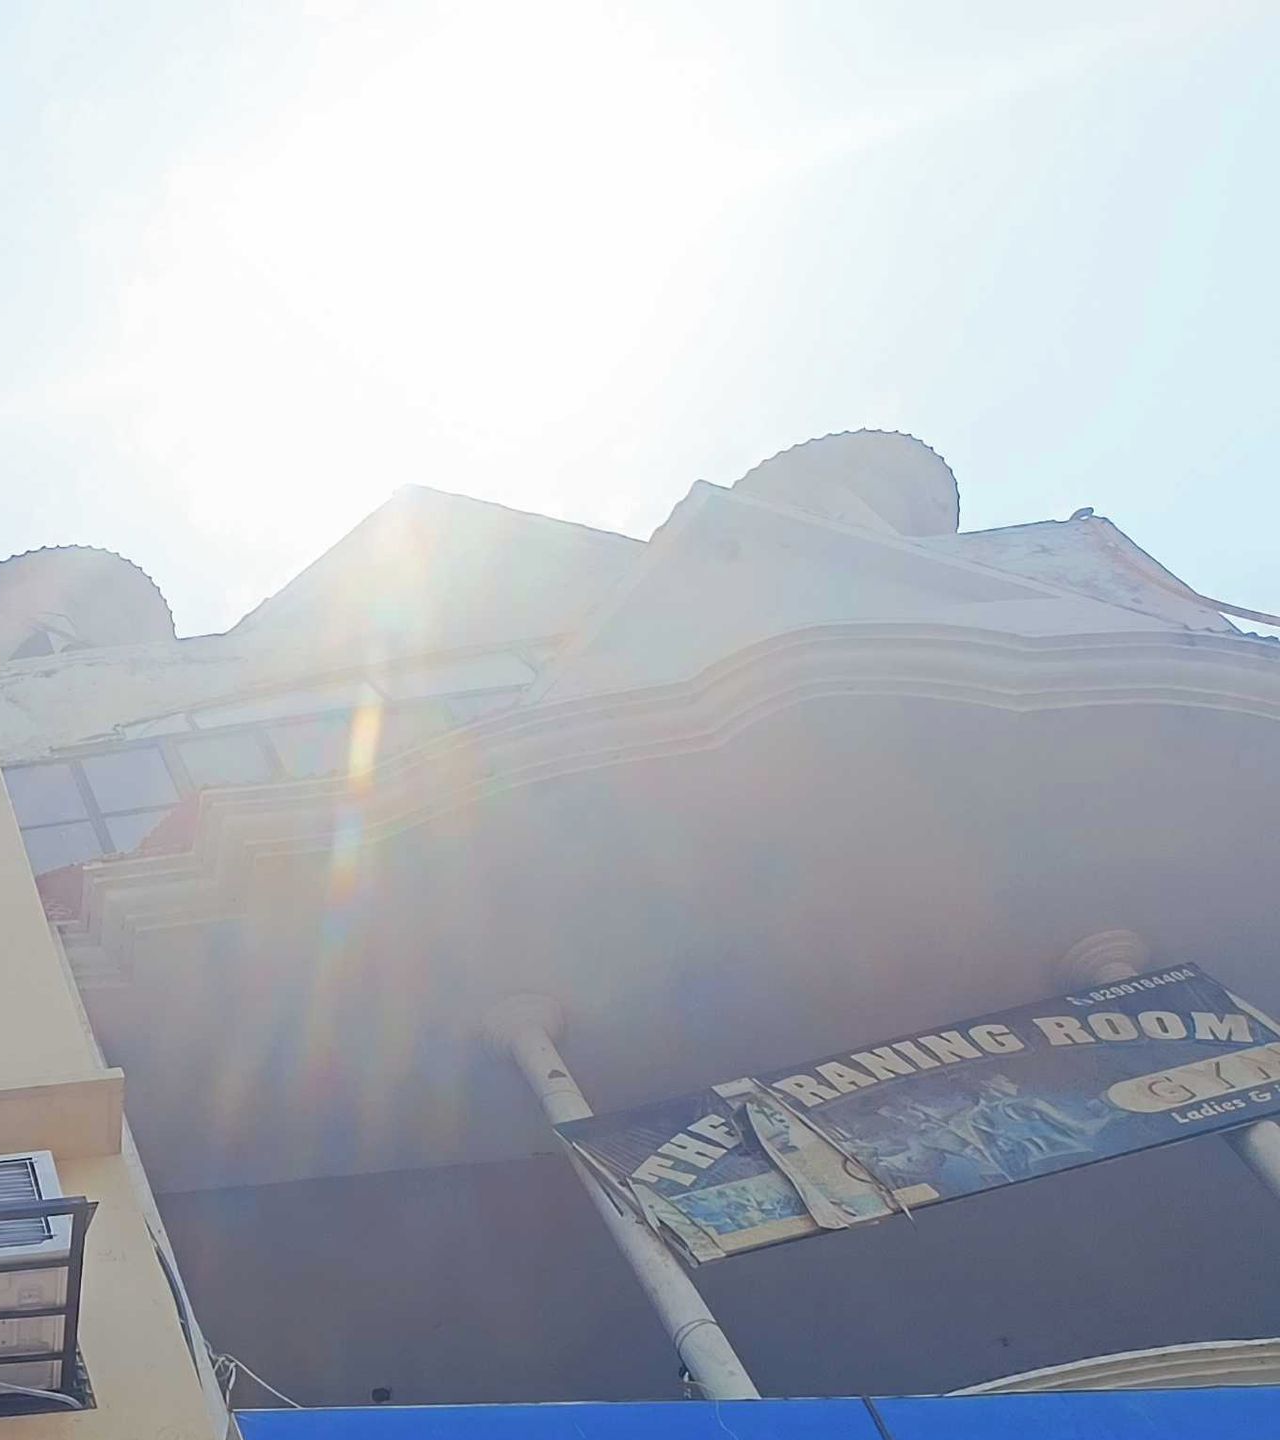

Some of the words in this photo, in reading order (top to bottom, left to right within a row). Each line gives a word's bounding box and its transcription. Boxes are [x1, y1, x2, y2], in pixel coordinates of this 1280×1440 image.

[631, 1113, 743, 1187] THE
[1034, 1010, 1254, 1047] ROOM
[1171, 1098, 1247, 1124] Ladies
